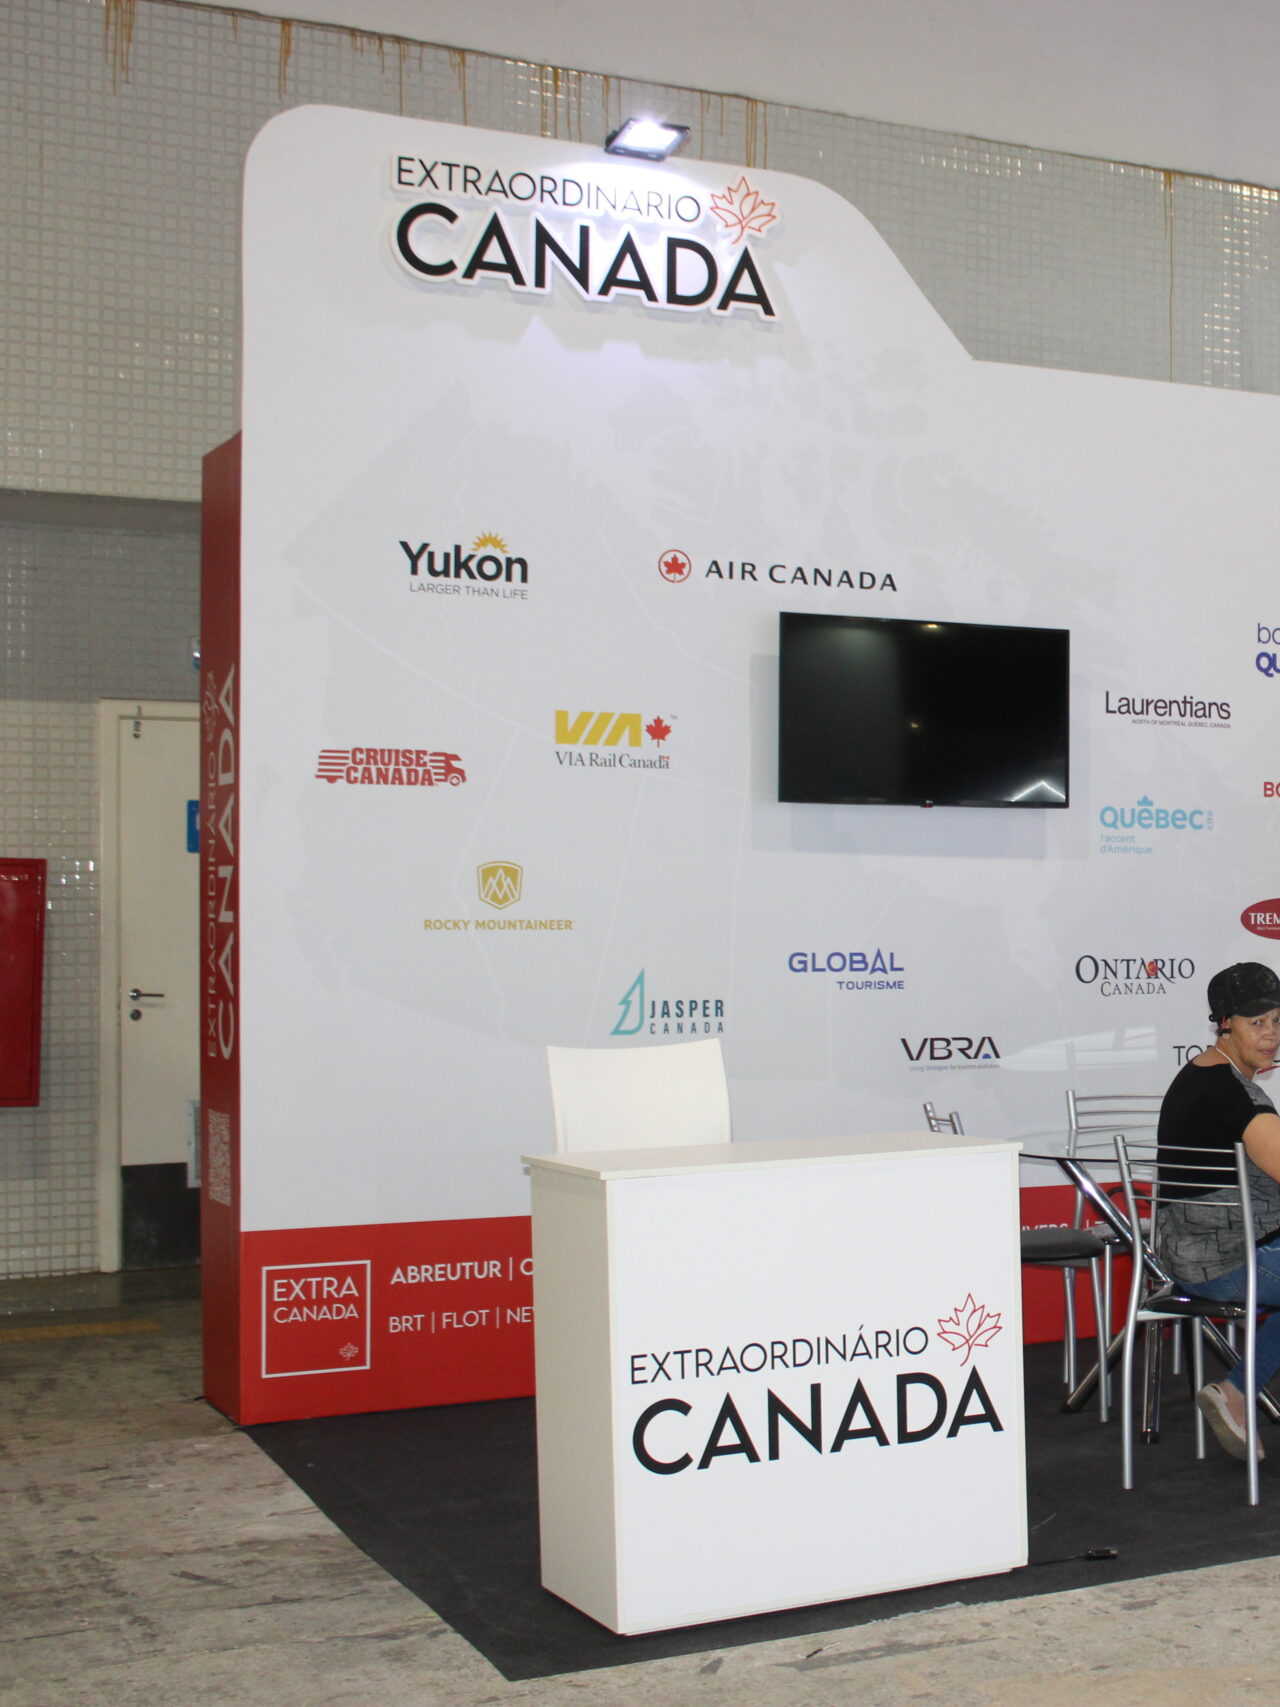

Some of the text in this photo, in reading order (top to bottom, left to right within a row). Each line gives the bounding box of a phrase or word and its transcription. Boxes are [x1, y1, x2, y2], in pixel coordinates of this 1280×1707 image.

[396, 201, 776, 317] CANADA
[399, 540, 529, 584] Yukon
[705, 559, 898, 593] AIR CANADA
[409, 581, 529, 600] LARGER THAN LIFE
[1105, 690, 1231, 720] Laurentians
[554, 710, 642, 747] VIA
[351, 747, 429, 769] CRUISE
[555, 750, 670, 769] VIA Rail Canada
[344, 766, 435, 787] CANADA
[218, 662, 236, 1060] CANADA
[207, 752, 217, 1059] EXTRAORDINÁRIO
[424, 919, 573, 931] ROCKY MOUNTAINEER
[788, 947, 905, 975] GLOBAL
[1075, 955, 1195, 984] ONTARIO
[837, 980, 905, 990] TOURISME
[1100, 982, 1167, 997] CANADA
[649, 999, 724, 1019] JASPER
[649, 1022, 724, 1035] CANADA
[900, 1036, 1001, 1061] VBRA
[391, 1260, 503, 1285] ABREUTUR
[273, 1276, 359, 1301] EXTRA
[273, 1303, 359, 1324] CANADA
[389, 1310, 490, 1333] BRT FLOT
[630, 1324, 929, 1385] EXTRAORDINÁRIO
[632, 1365, 1005, 1476] CANADA
